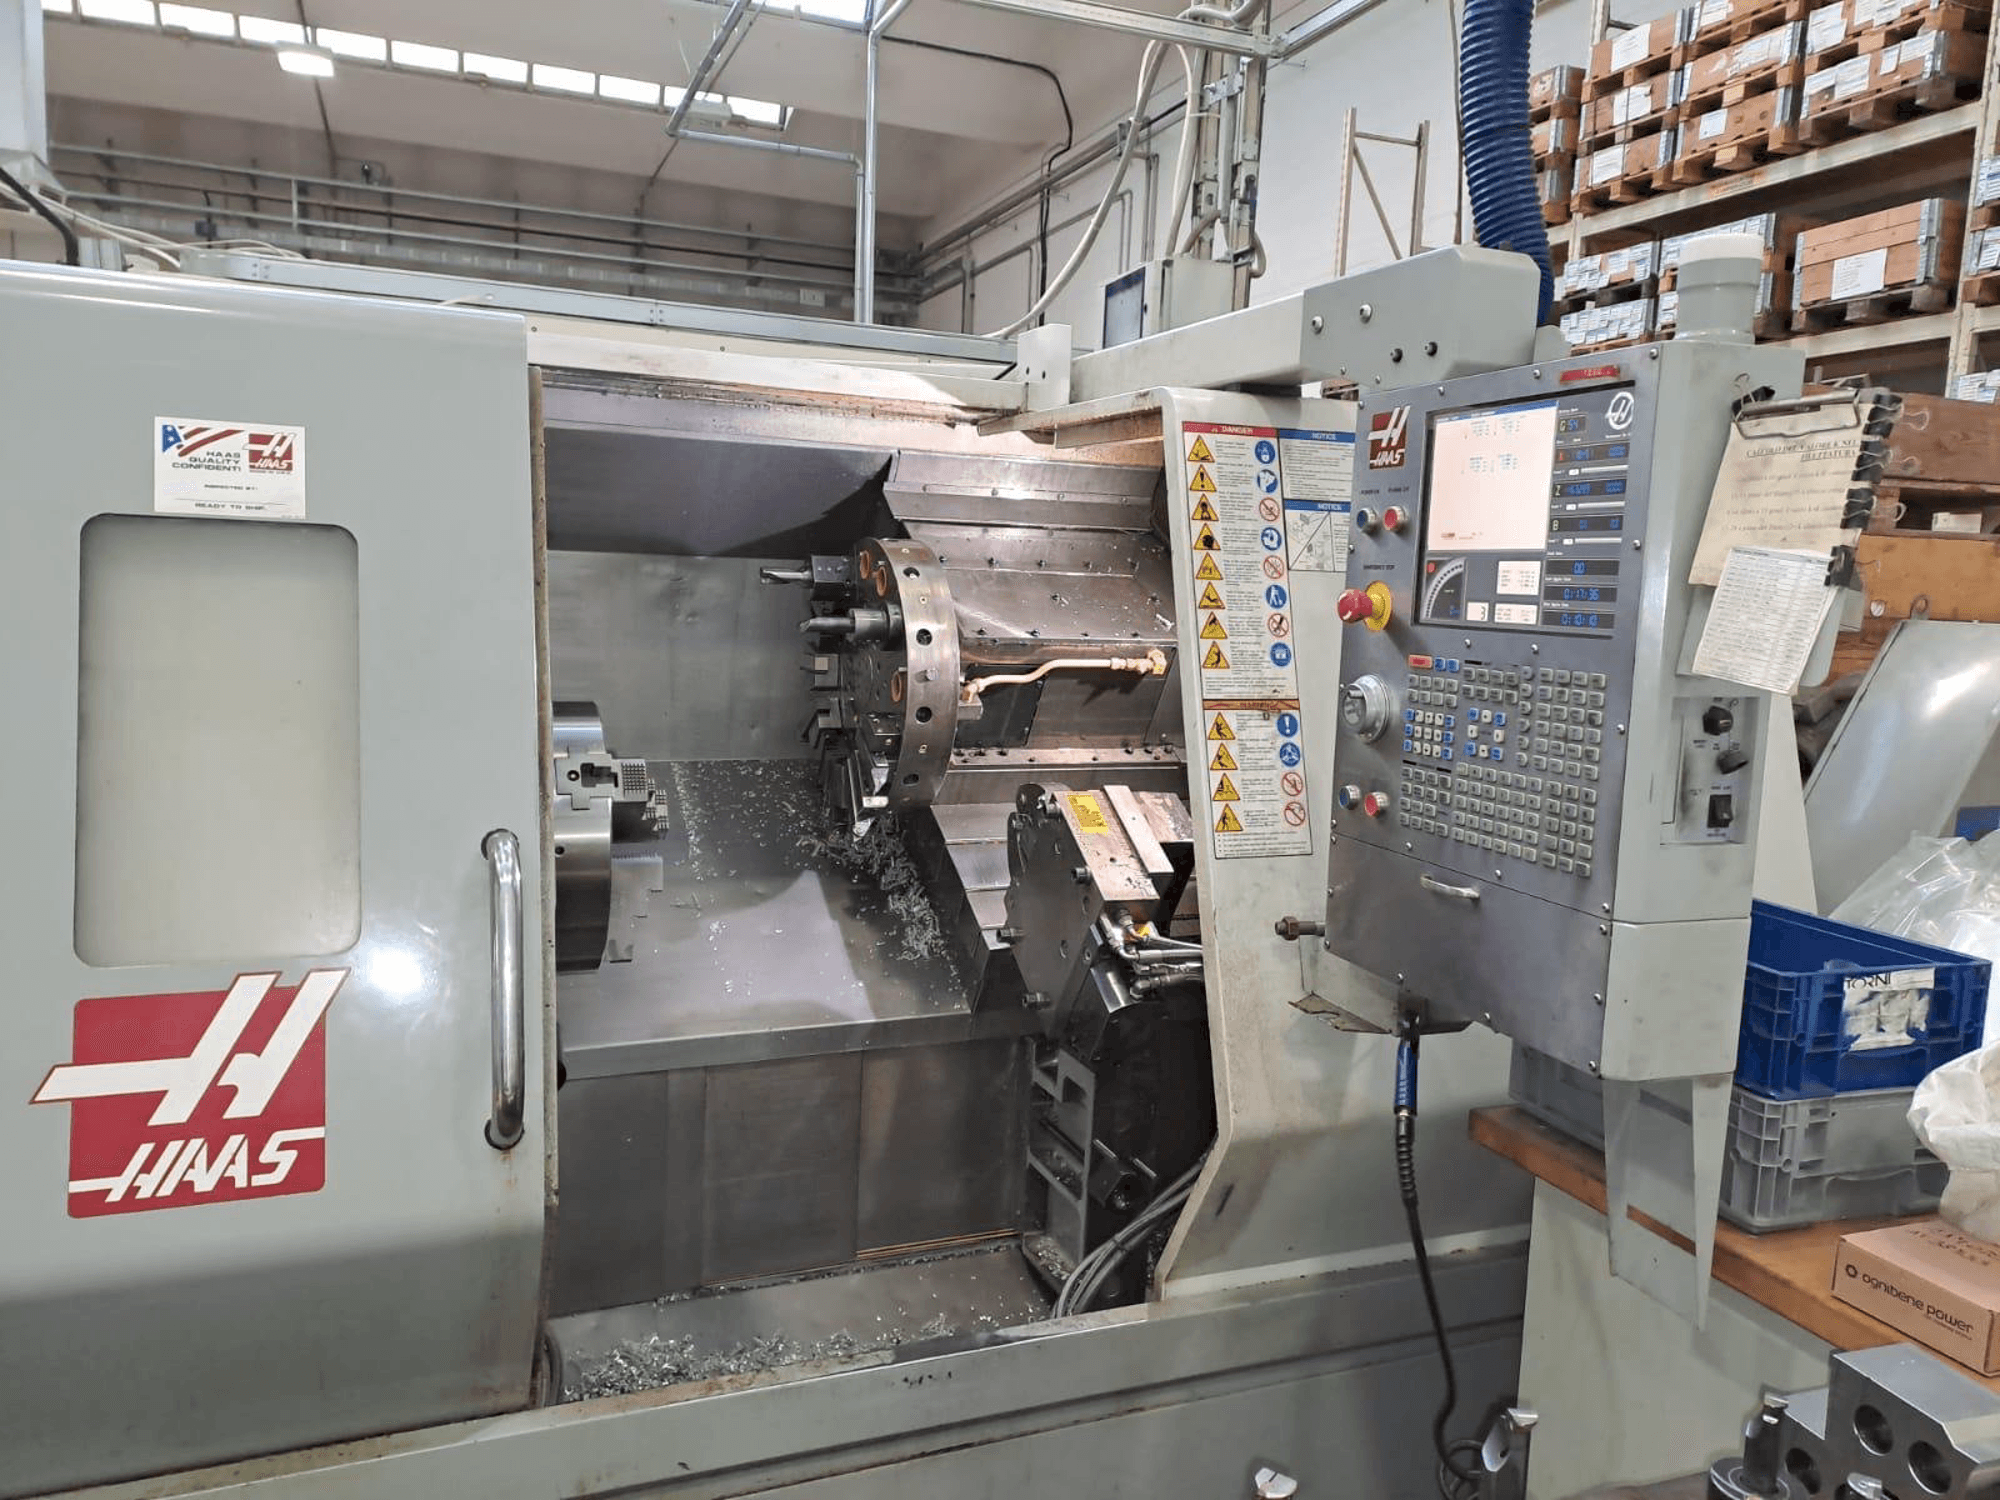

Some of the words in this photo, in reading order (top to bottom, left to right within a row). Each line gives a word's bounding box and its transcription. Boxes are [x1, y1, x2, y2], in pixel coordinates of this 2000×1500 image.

[1221, 425, 1253, 434] DANGER
[1313, 432, 1336, 441] NOTICE
[189, 456, 241, 465] QUALITY
[1369, 449, 1406, 467] HAAS
[248, 458, 293, 470] HAAS
[1317, 503, 1342, 511] NOTICE
[68, 1126, 325, 1203] HAAS
[1862, 1273, 1925, 1311] ognibene
[1926, 1304, 1974, 1334] power
